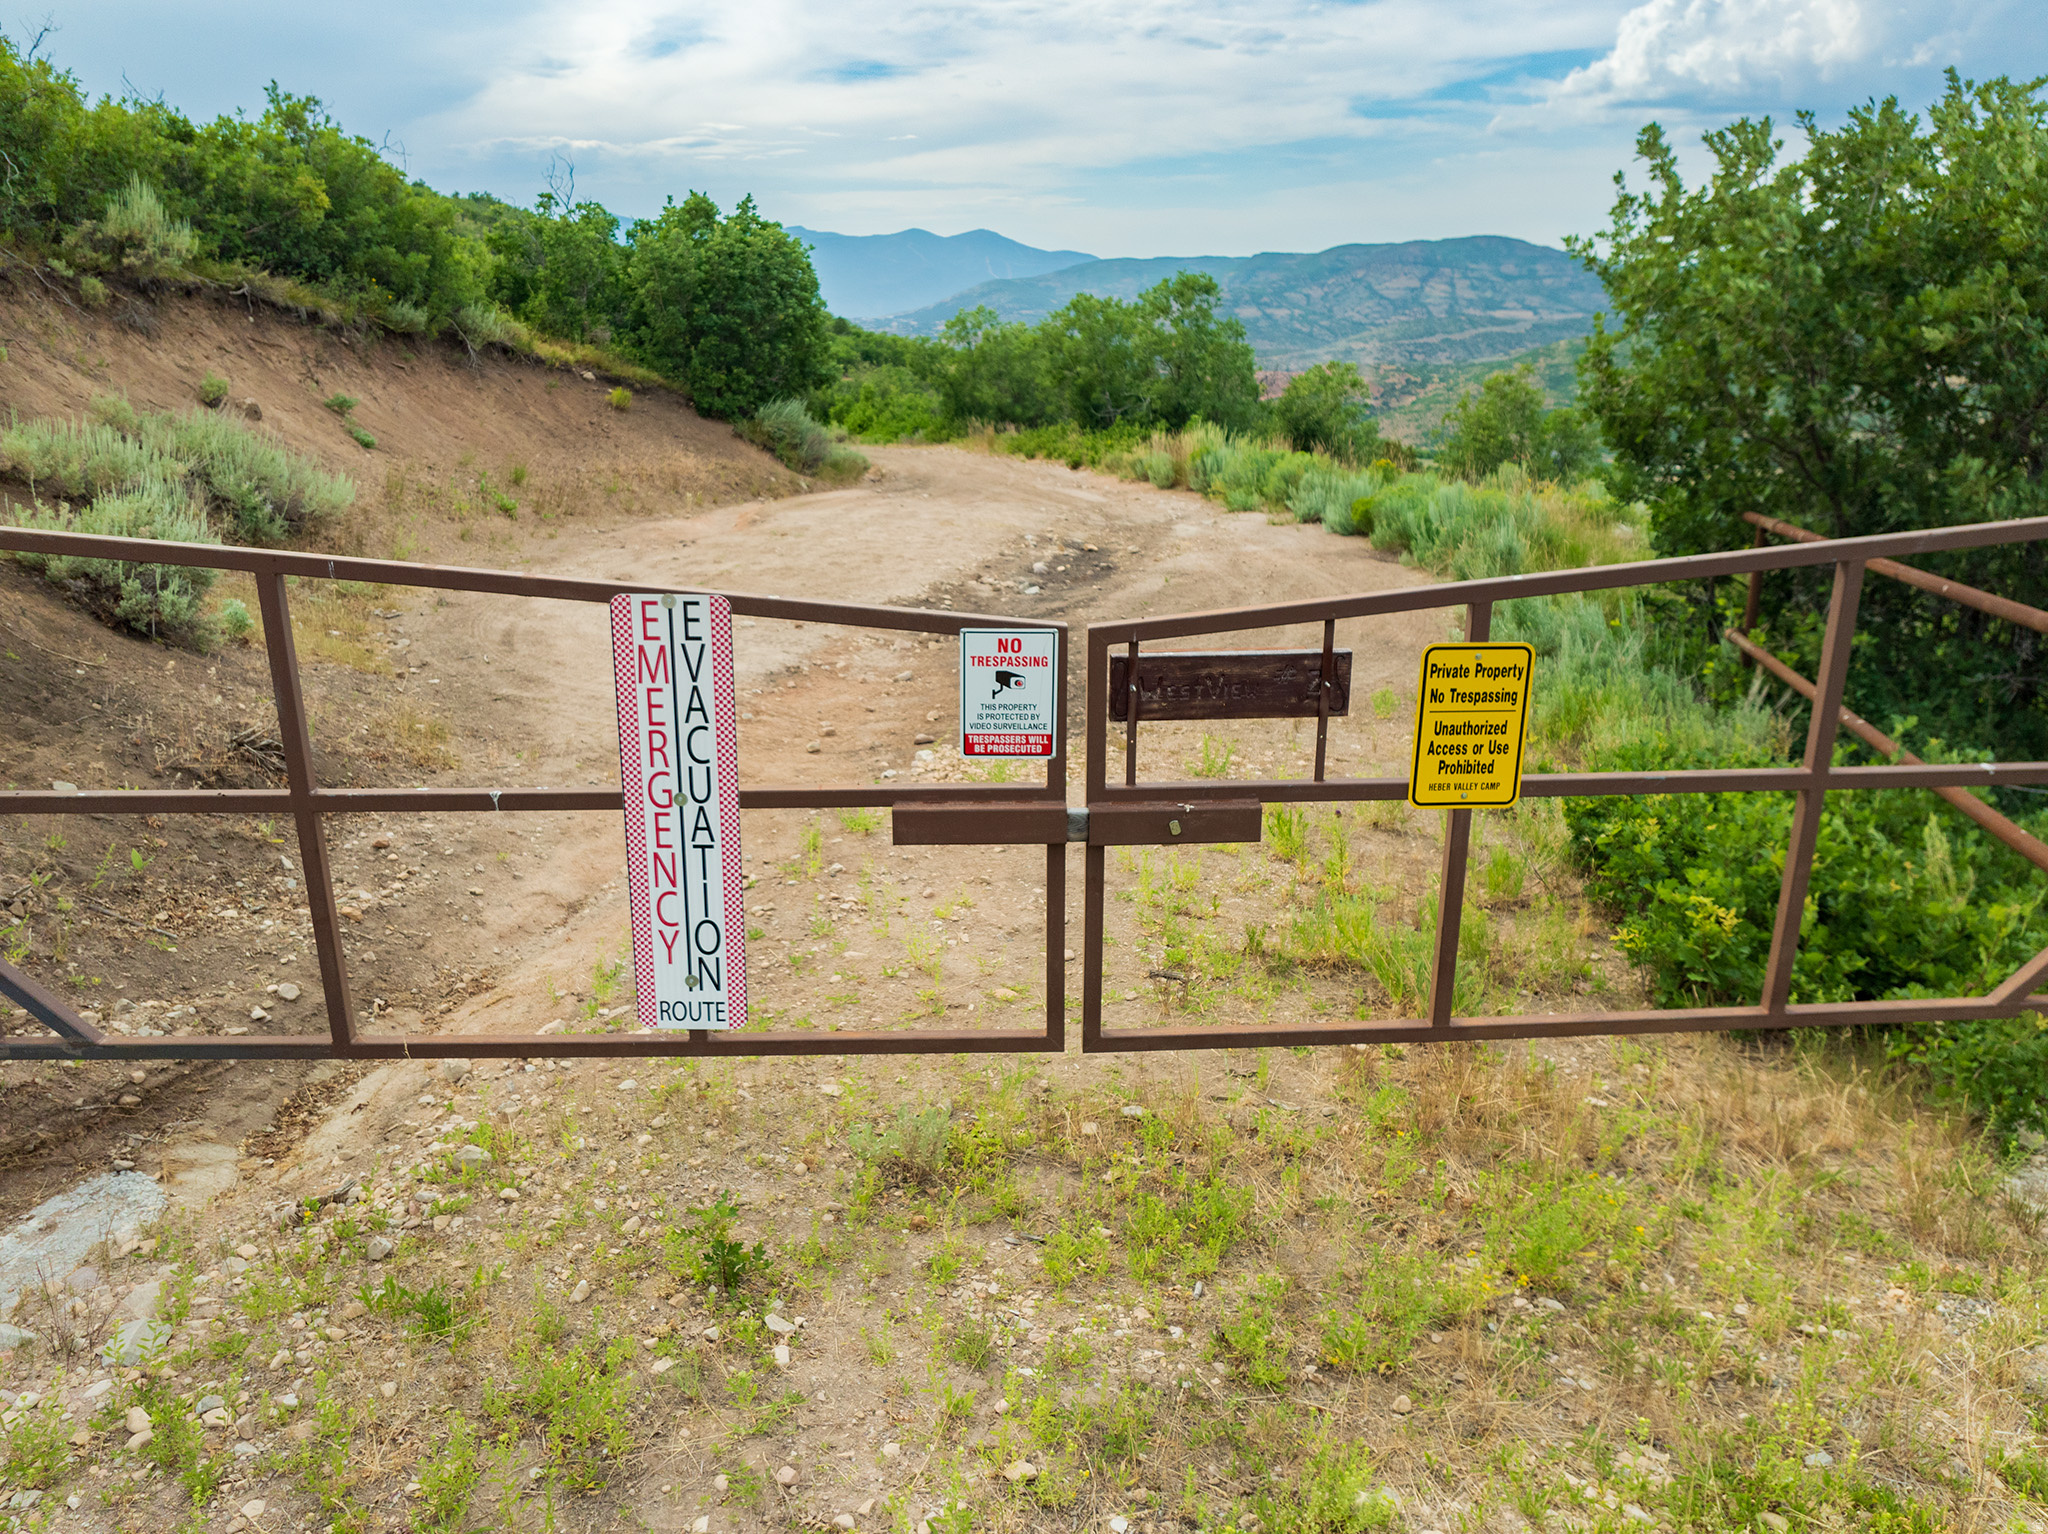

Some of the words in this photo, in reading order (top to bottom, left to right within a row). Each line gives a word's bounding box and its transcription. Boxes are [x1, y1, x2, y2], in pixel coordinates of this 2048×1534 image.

[998, 638, 1021, 653] NO
[971, 656, 1048, 667] TRESPASSING
[1430, 664, 1470, 678] Private
[1475, 663, 1524, 681] Property
[1430, 688, 1444, 703] No
[1450, 688, 1518, 705] Trespassing
[1434, 720, 1508, 736] Unauthorized
[968, 735, 1026, 744] TRESPASSERS
[1028, 736, 1048, 744] WILL
[987, 745, 1042, 753] PROSECUTED
[1427, 741, 1468, 755] Access
[1473, 744, 1484, 754] or
[1488, 740, 1509, 754] Use
[1438, 759, 1494, 774] Prohibited
[637, 600, 679, 964] EMERGENCY
[1429, 783, 1450, 791] HEBER
[1481, 782, 1500, 790] CAMP
[681, 600, 721, 991] EVACUATION
[659, 1000, 726, 1022] ROUTE
